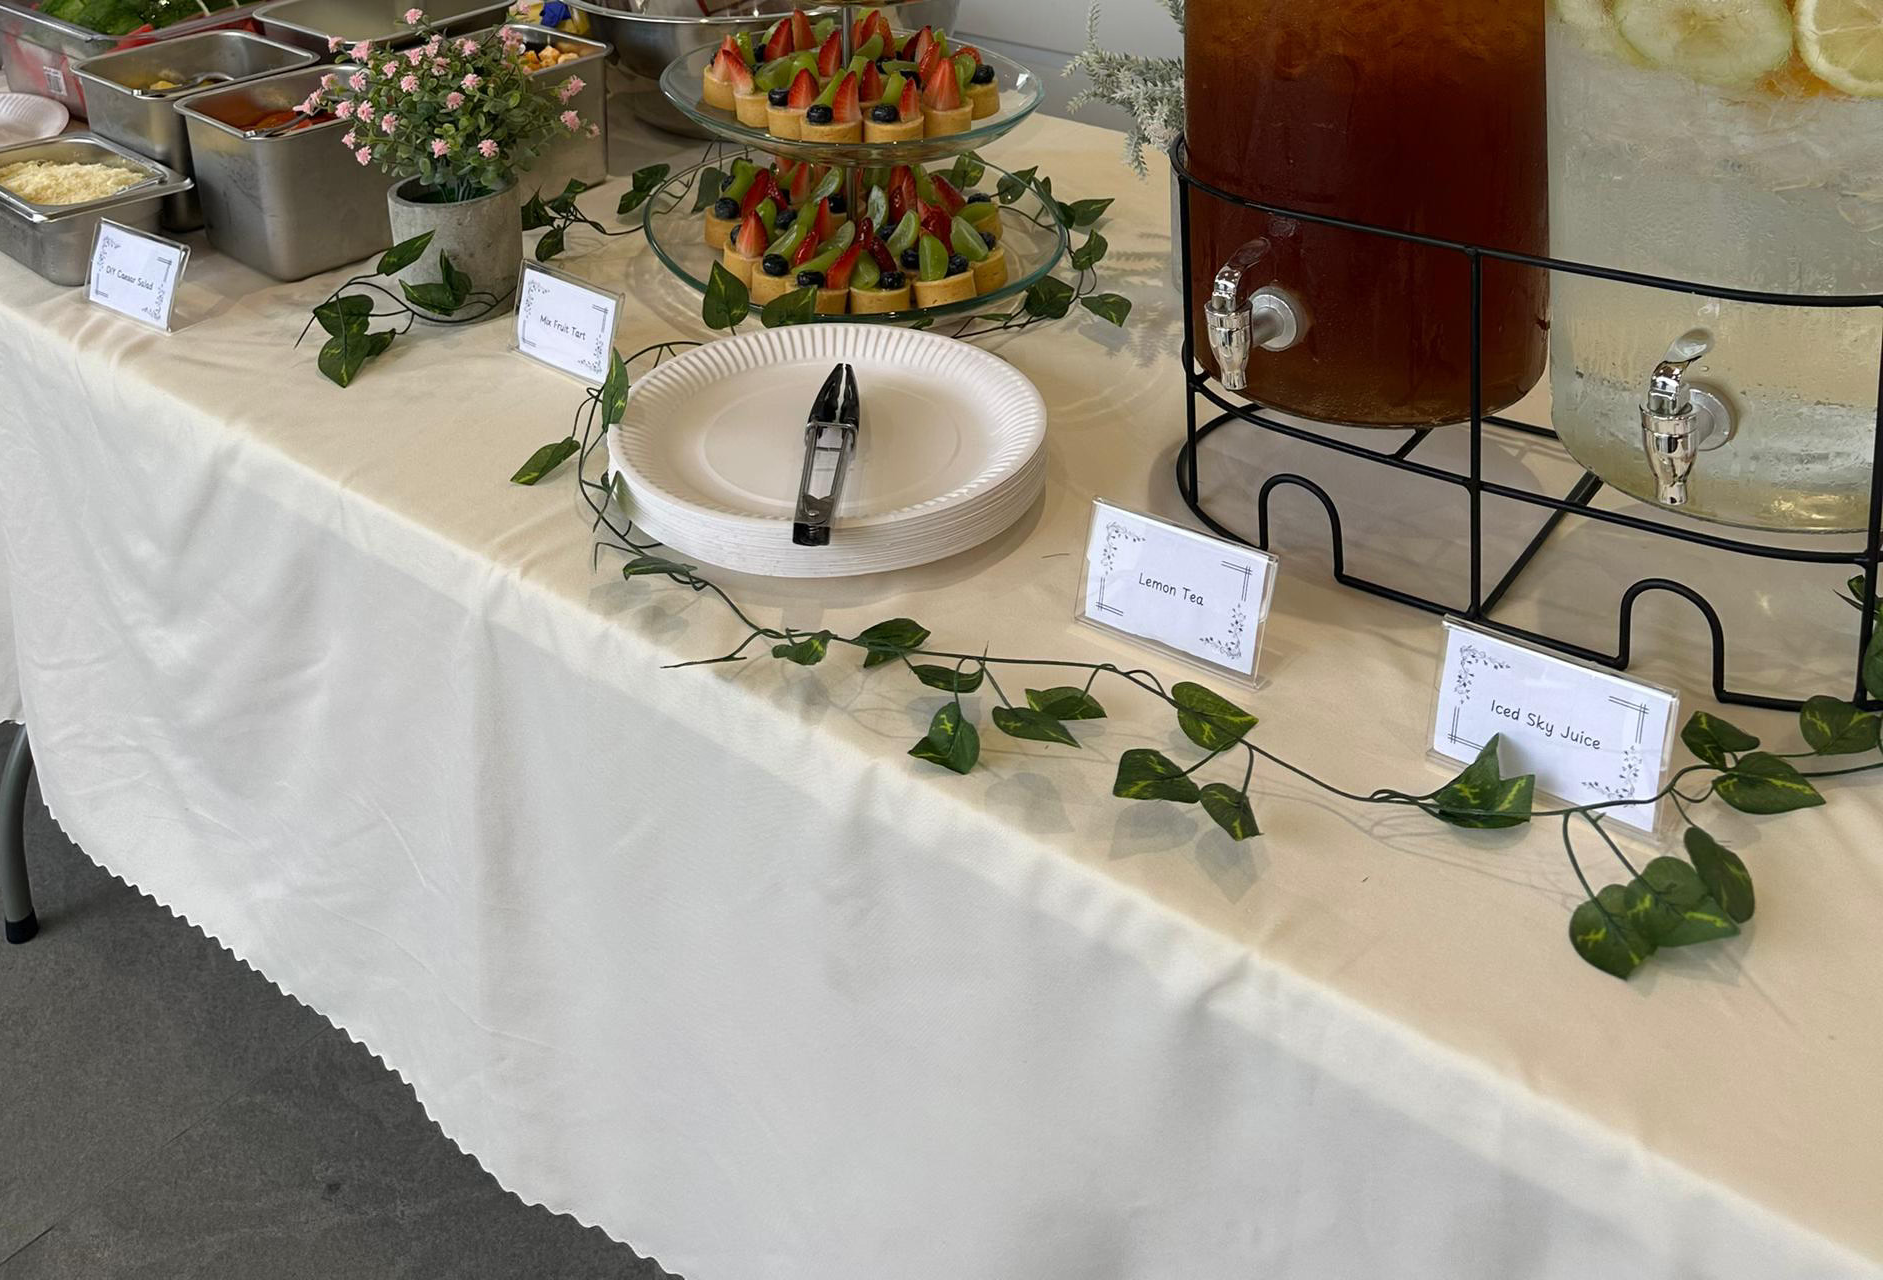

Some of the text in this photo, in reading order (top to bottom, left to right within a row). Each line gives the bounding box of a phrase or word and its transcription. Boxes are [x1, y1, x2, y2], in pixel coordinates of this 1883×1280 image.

[106, 265, 116, 275] DIY
[137, 278, 153, 291] Salad
[540, 315, 586, 341] Mix Fruit Tart
[1139, 572, 1204, 606] Lemon Tea
[1490, 699, 1601, 750] Iced Sky Juice
